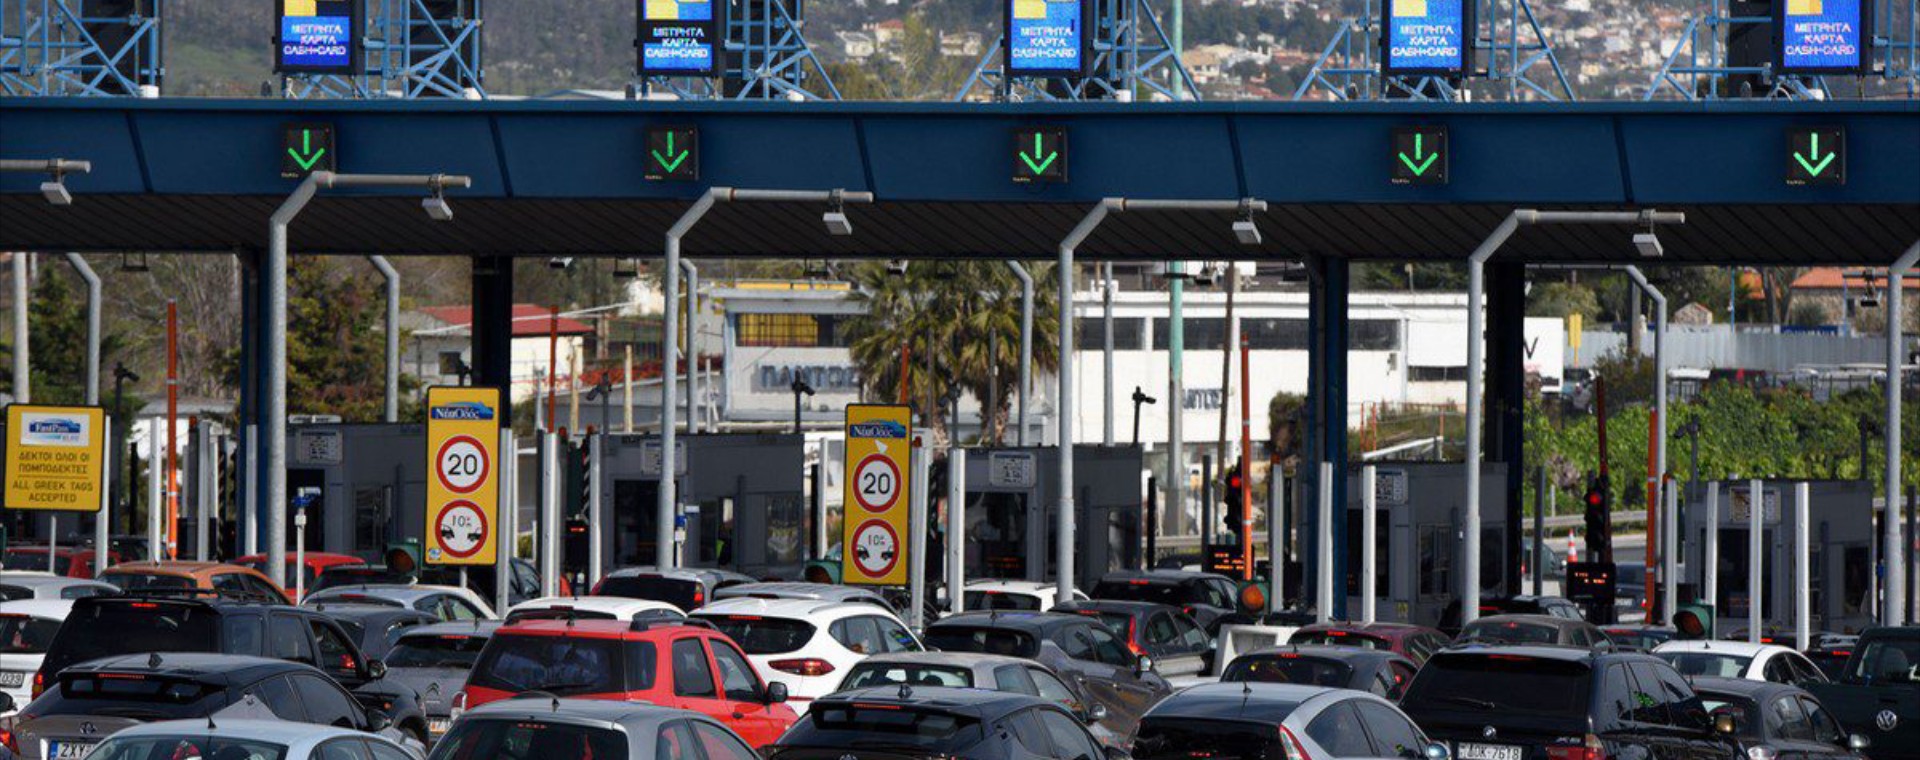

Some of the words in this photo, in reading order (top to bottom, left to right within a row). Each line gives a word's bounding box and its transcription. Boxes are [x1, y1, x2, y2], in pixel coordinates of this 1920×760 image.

[19, 451, 52, 461] ΔΕΚΤΟΙ
[55, 451, 77, 461] ΟΛΟΙ
[80, 452, 90, 462] ΟΙ
[19, 464, 88, 474] ΠΟΜΠΟΔΕΚΤΕΣ
[447, 453, 478, 475] 20
[13, 480, 28, 490] ALL
[34, 480, 65, 490] GREEK
[71, 481, 94, 491] TAGS
[863, 472, 891, 495] 20
[29, 493, 77, 503] ACCEPTED
